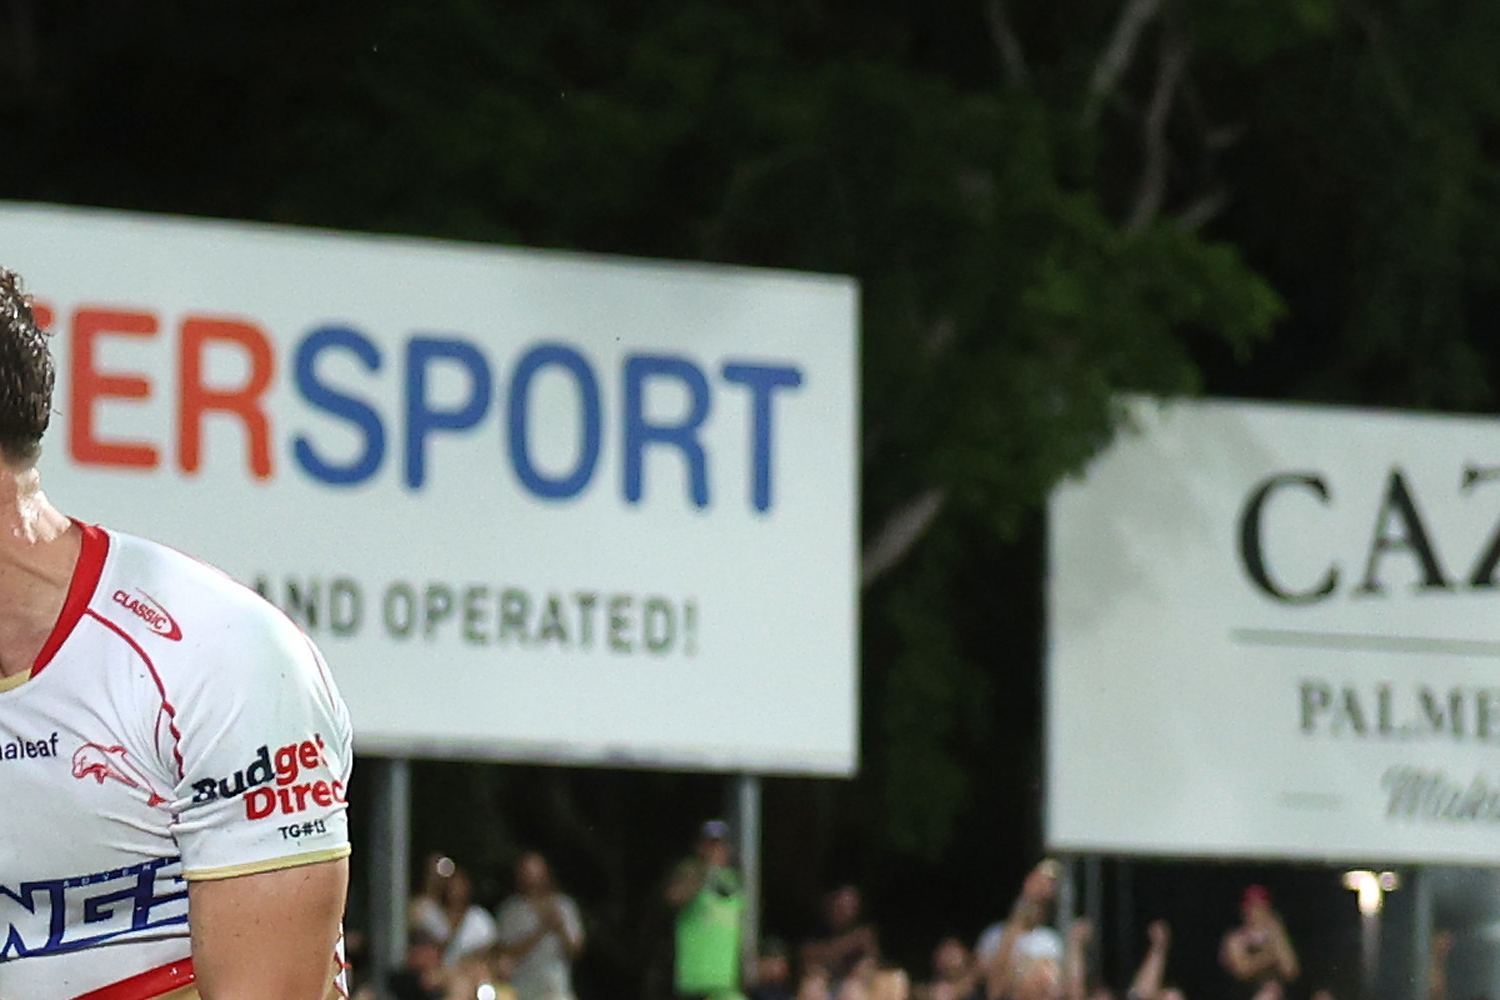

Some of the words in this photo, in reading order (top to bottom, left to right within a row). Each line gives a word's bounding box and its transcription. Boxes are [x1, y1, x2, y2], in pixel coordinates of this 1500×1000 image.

[112, 588, 167, 631] CLASSIC
[381, 582, 699, 656] OPERATED!
[243, 778, 348, 821] Direc
